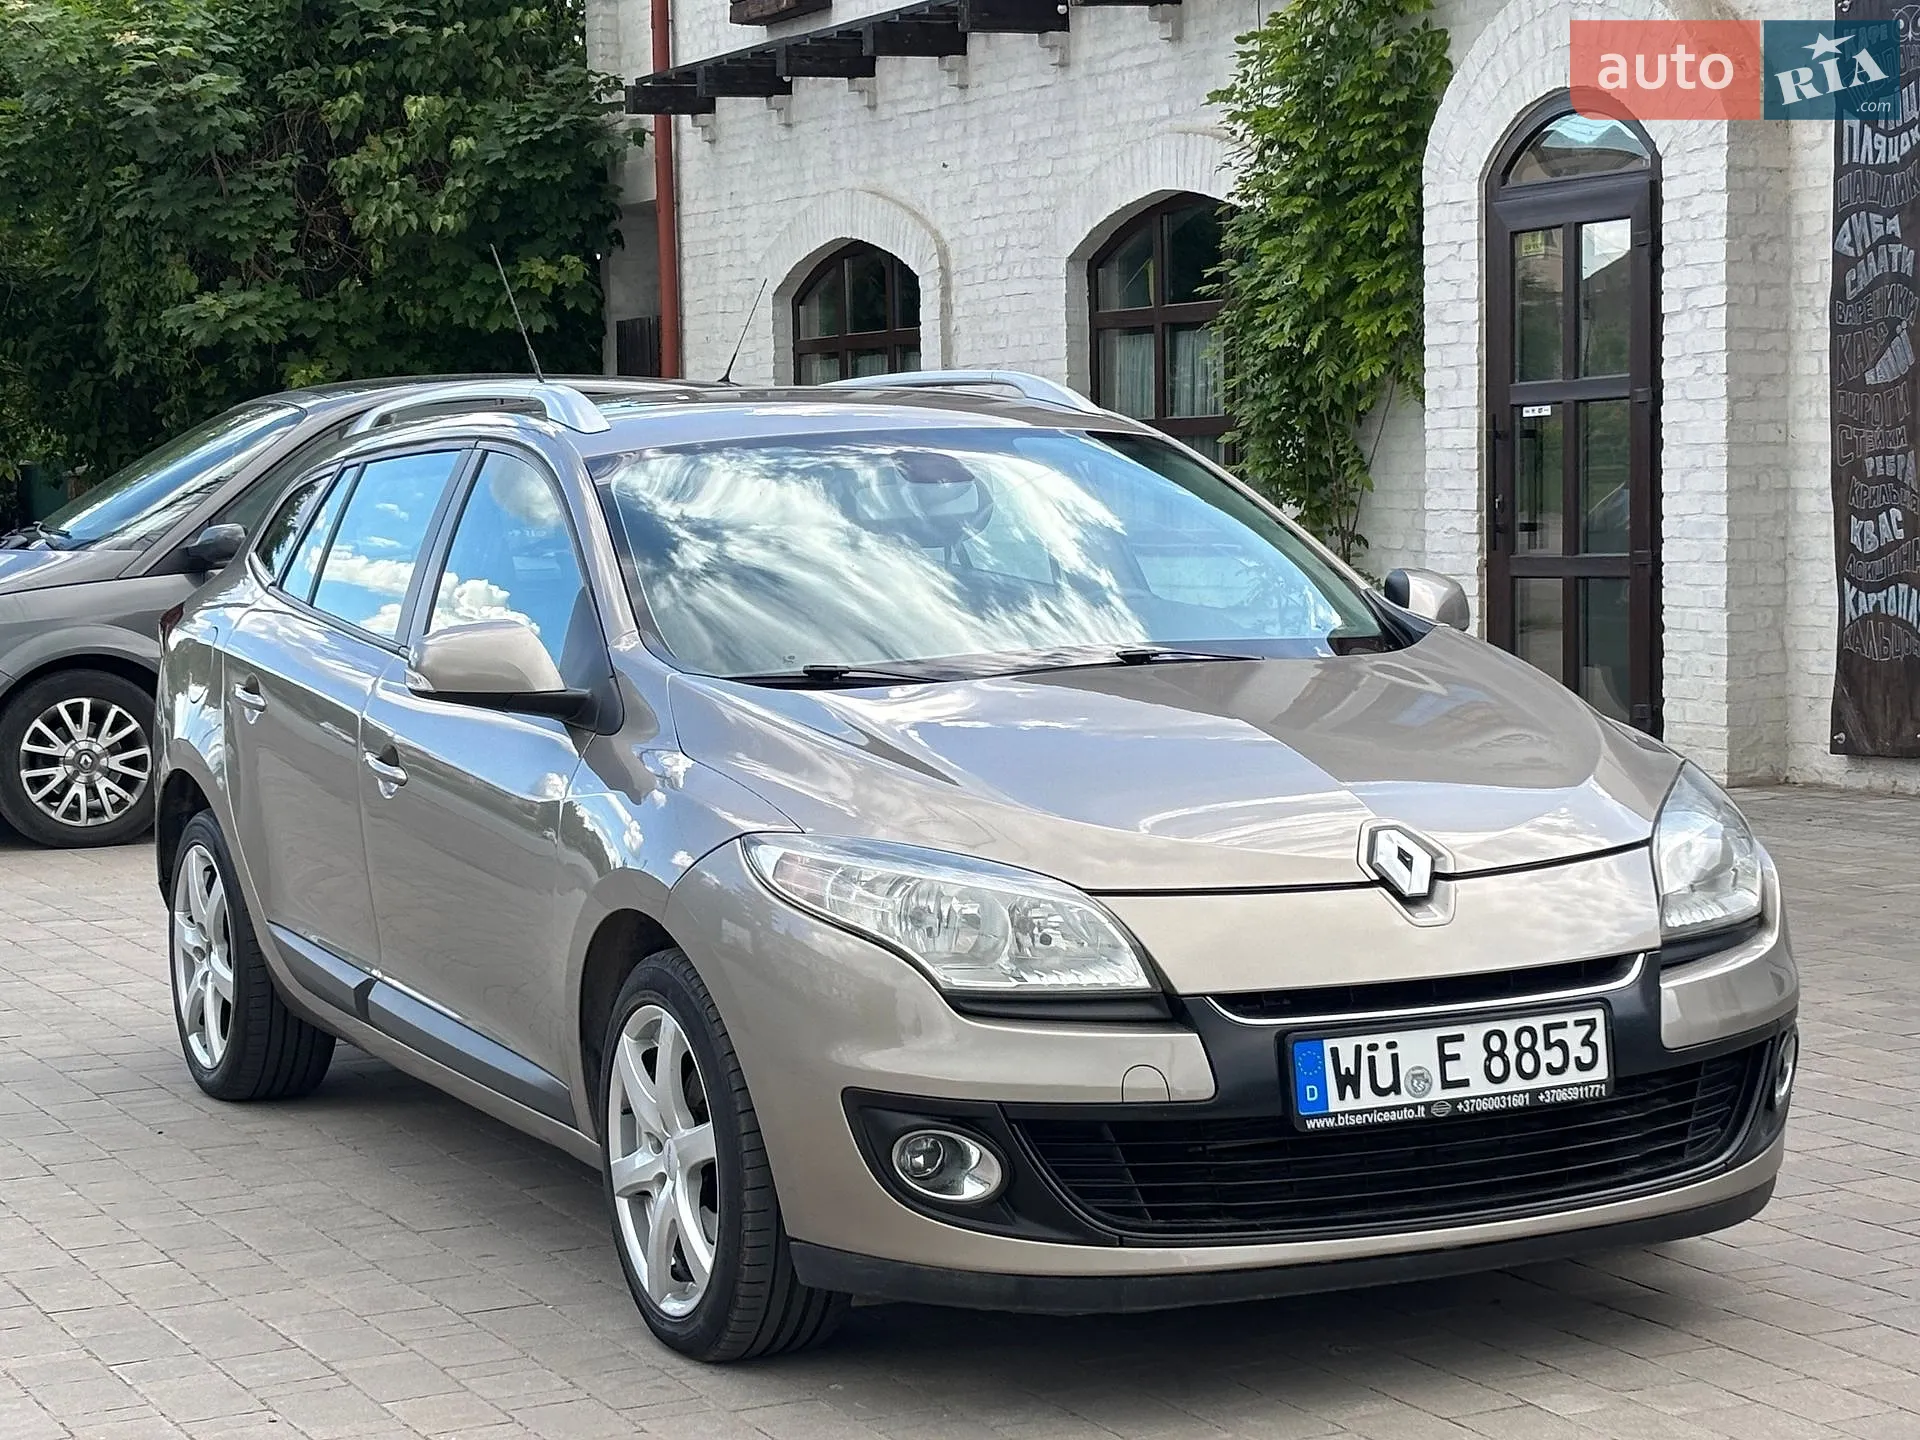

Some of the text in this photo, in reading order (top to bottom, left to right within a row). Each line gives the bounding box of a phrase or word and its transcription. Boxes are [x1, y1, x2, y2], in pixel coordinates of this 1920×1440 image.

[1834, 211, 1901, 257] РИБА
[1846, 244, 1914, 300] САЛАТИ
[1836, 284, 1919, 326] ВАРЕНИКИ
[1837, 381, 1911, 426] ПИРОГИ
[1837, 424, 1908, 466] СТЕЙКИ
[1865, 450, 1918, 492] РЕБРА
[1849, 476, 1920, 515] КРИЛЬЦЯ
[1850, 508, 1904, 553] КВАС
[1844, 577, 1920, 635] КАРТОПЛ
[1437, 1033, 1470, 1090] E
[1483, 1018, 1599, 1085] 8853
[1306, 1085, 1318, 1101] D
[1306, 1084, 1606, 1130] www.btserviceauto.lt +37060031601 +37065911771
